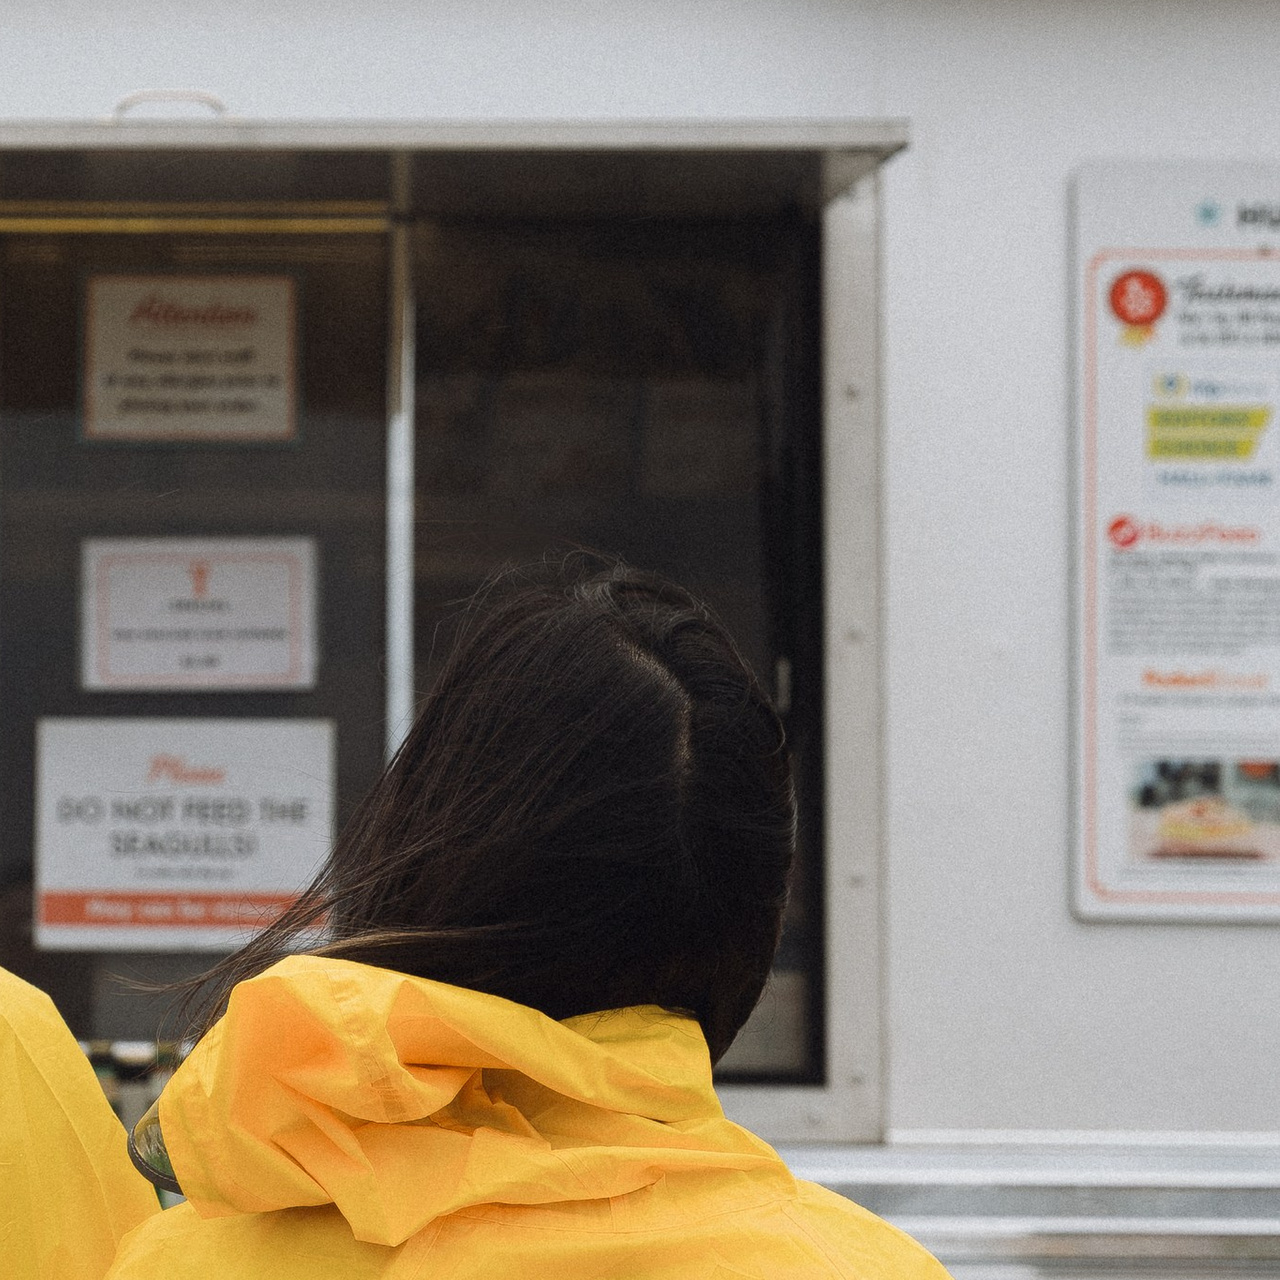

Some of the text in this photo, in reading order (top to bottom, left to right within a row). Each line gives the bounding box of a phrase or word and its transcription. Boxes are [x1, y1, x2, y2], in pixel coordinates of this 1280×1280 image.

[57, 797, 309, 823] DO NOT FEED THE
